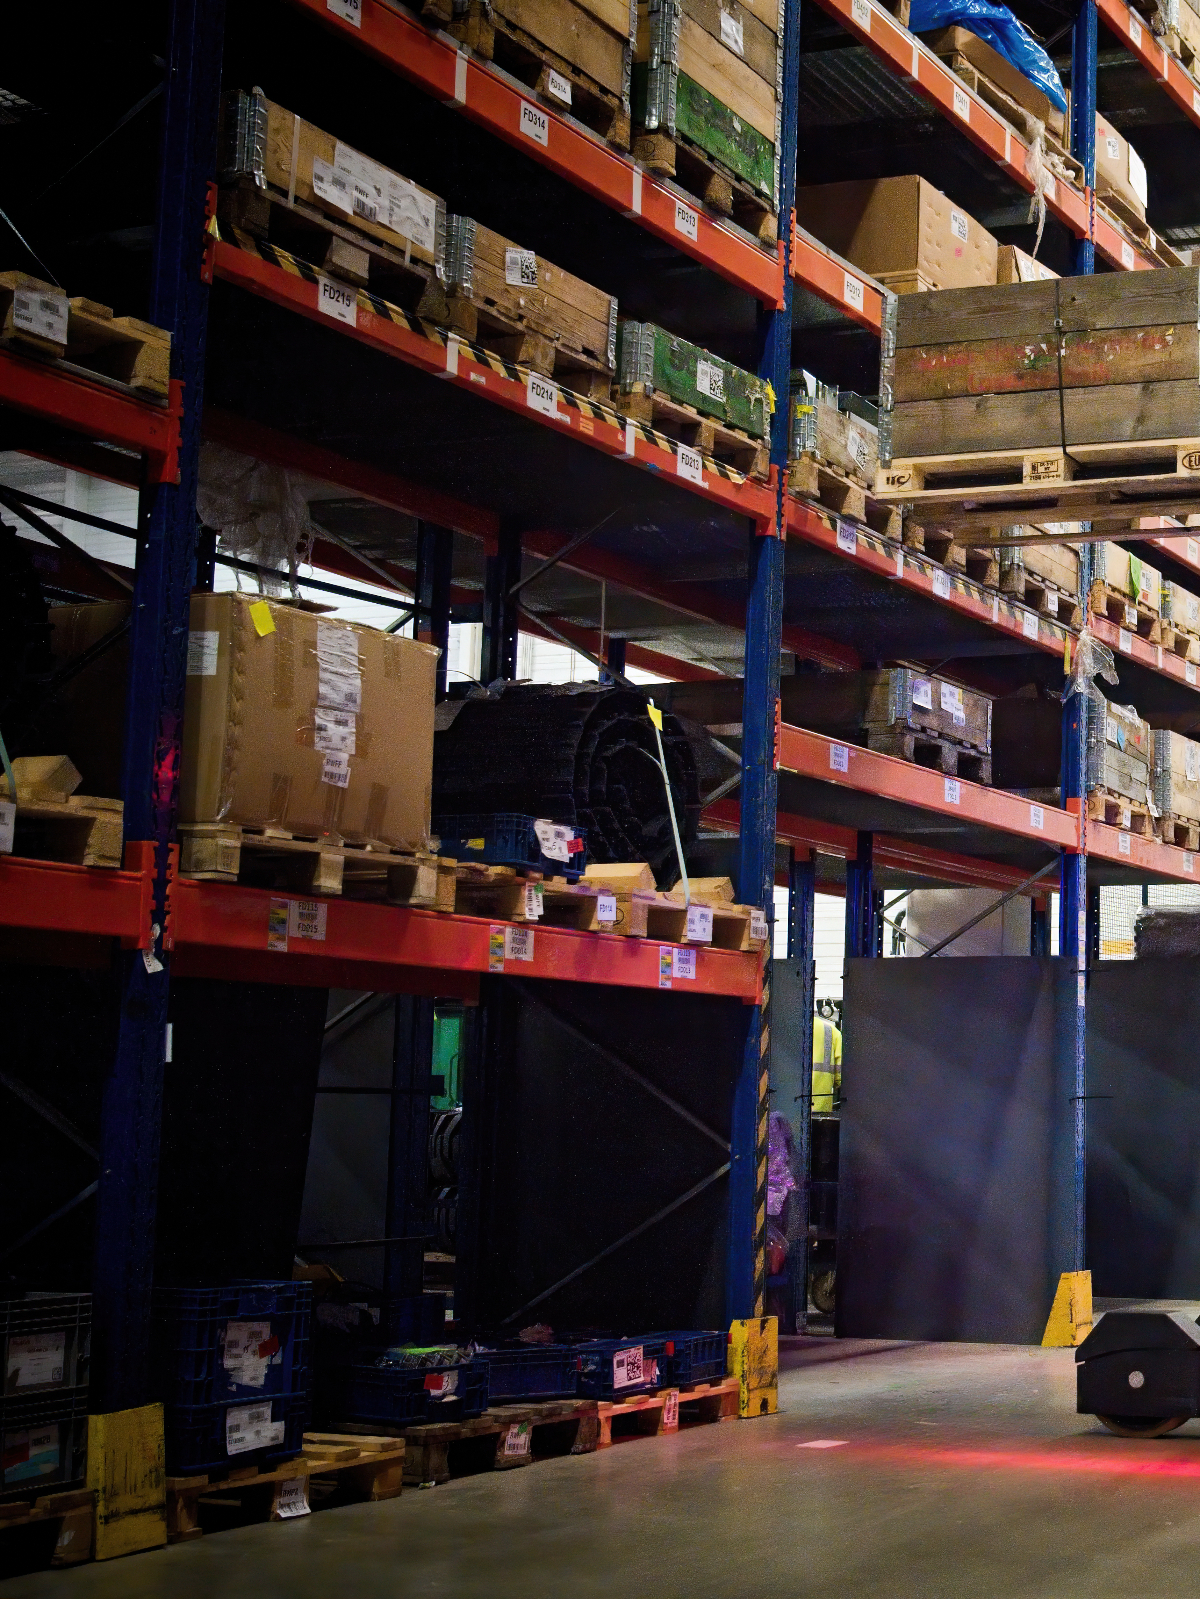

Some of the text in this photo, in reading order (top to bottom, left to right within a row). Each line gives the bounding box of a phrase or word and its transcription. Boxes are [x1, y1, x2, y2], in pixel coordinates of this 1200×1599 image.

[523, 107, 546, 131] FD314
[677, 206, 696, 227] FD313
[323, 283, 351, 308] FD215
[531, 382, 554, 403] FD214
[681, 452, 700, 470] FD213
